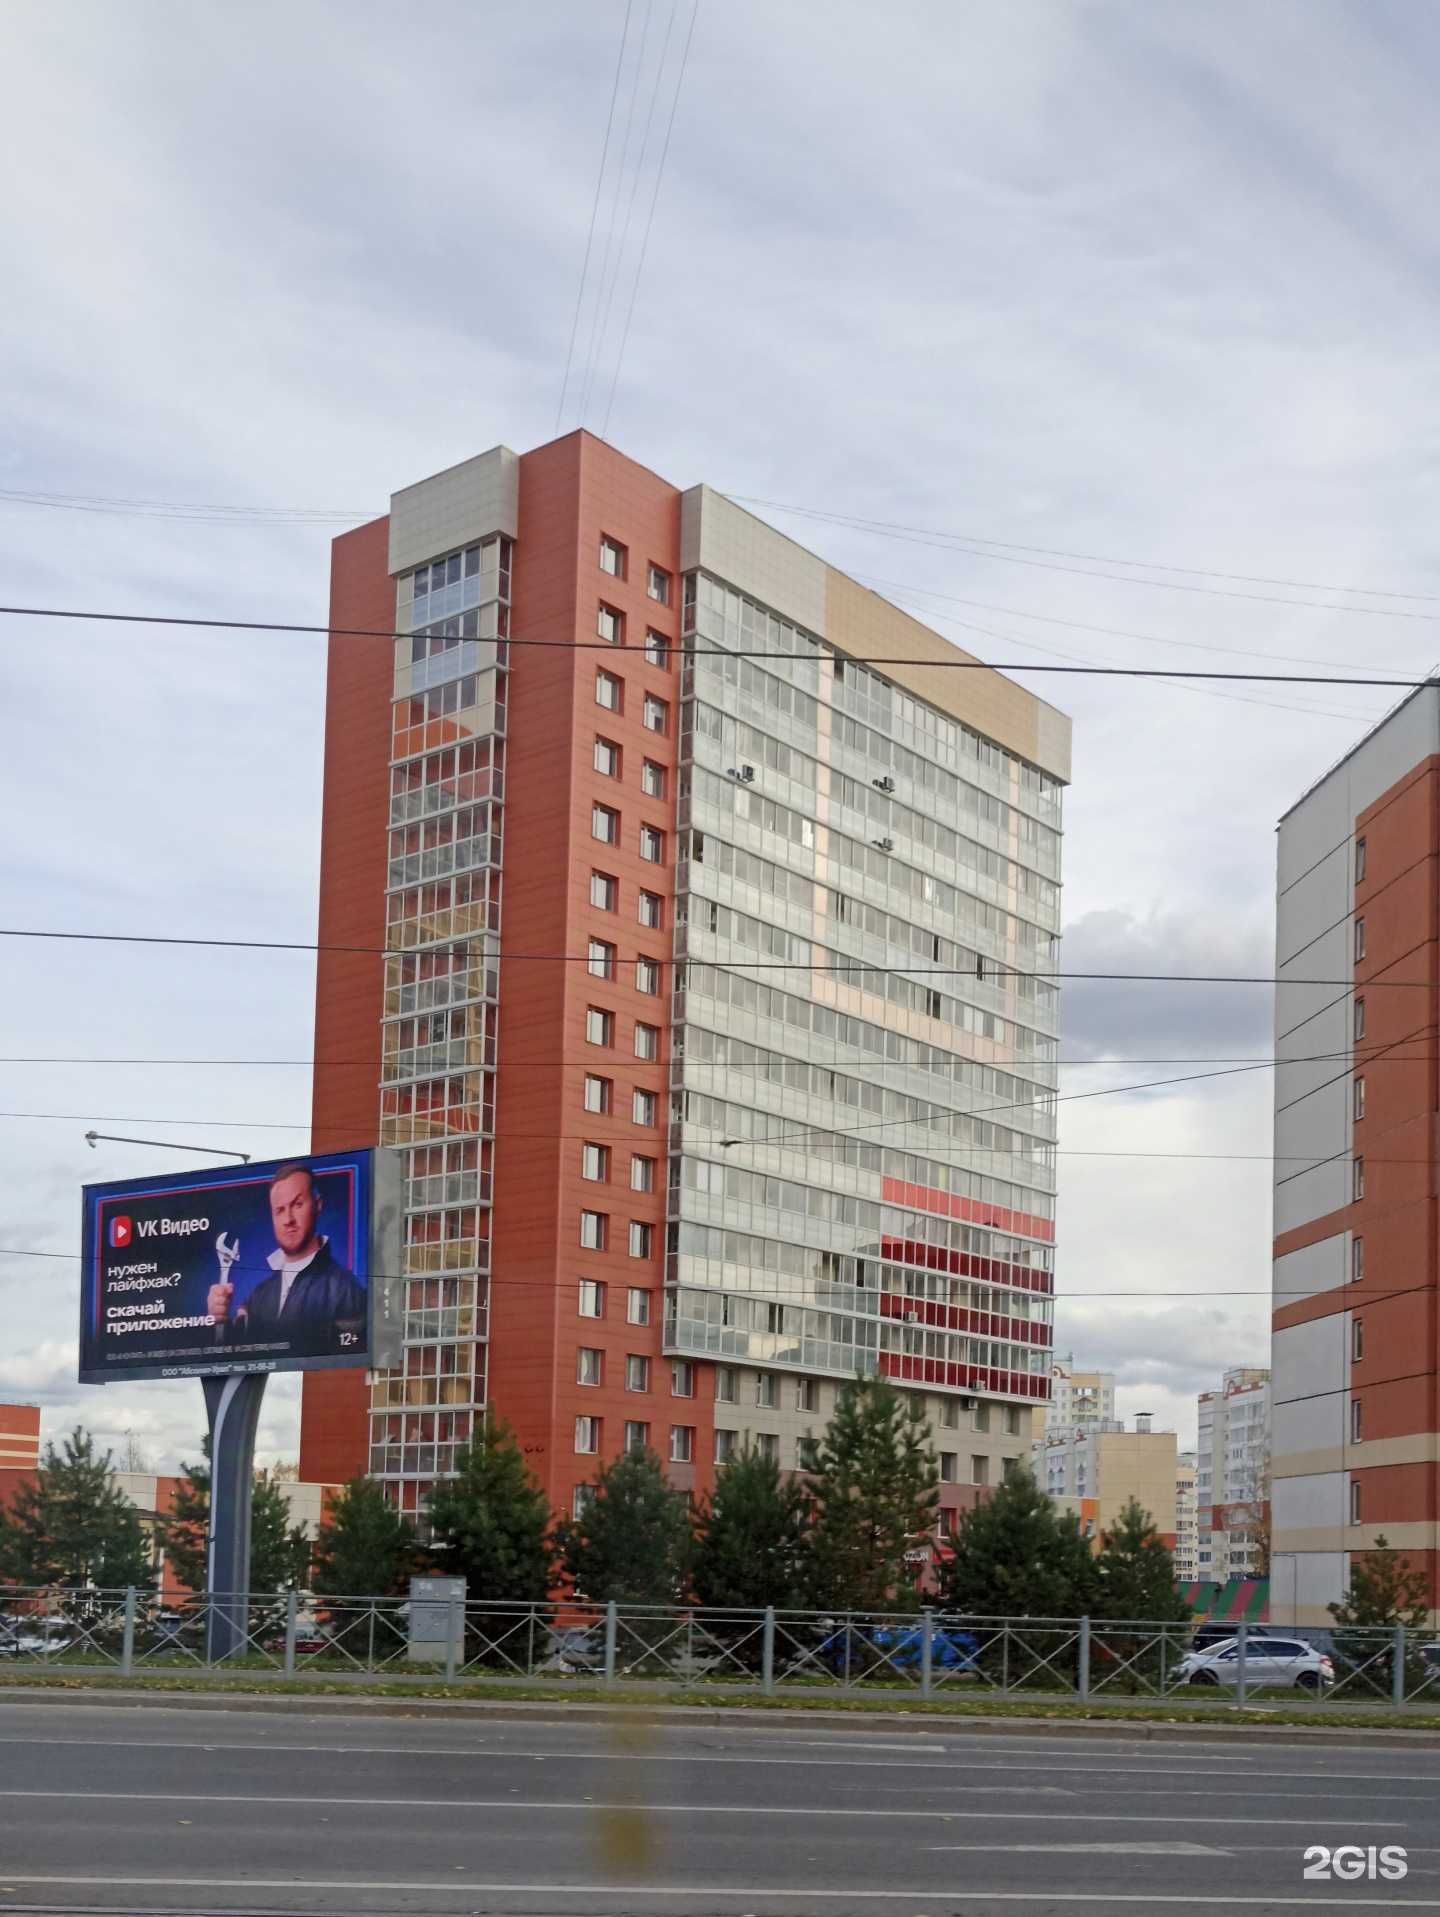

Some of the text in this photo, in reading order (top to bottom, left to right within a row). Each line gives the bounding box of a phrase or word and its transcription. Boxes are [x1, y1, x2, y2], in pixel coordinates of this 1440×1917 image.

[137, 1217, 210, 1238] VK Видео
[107, 1262, 158, 1279] нужен
[106, 1272, 182, 1293] лайфхак?
[106, 1299, 166, 1318] скачай
[106, 1314, 216, 1336] приложение
[339, 1332, 359, 1346] 12+
[161, 1367, 178, 1377] ООО
